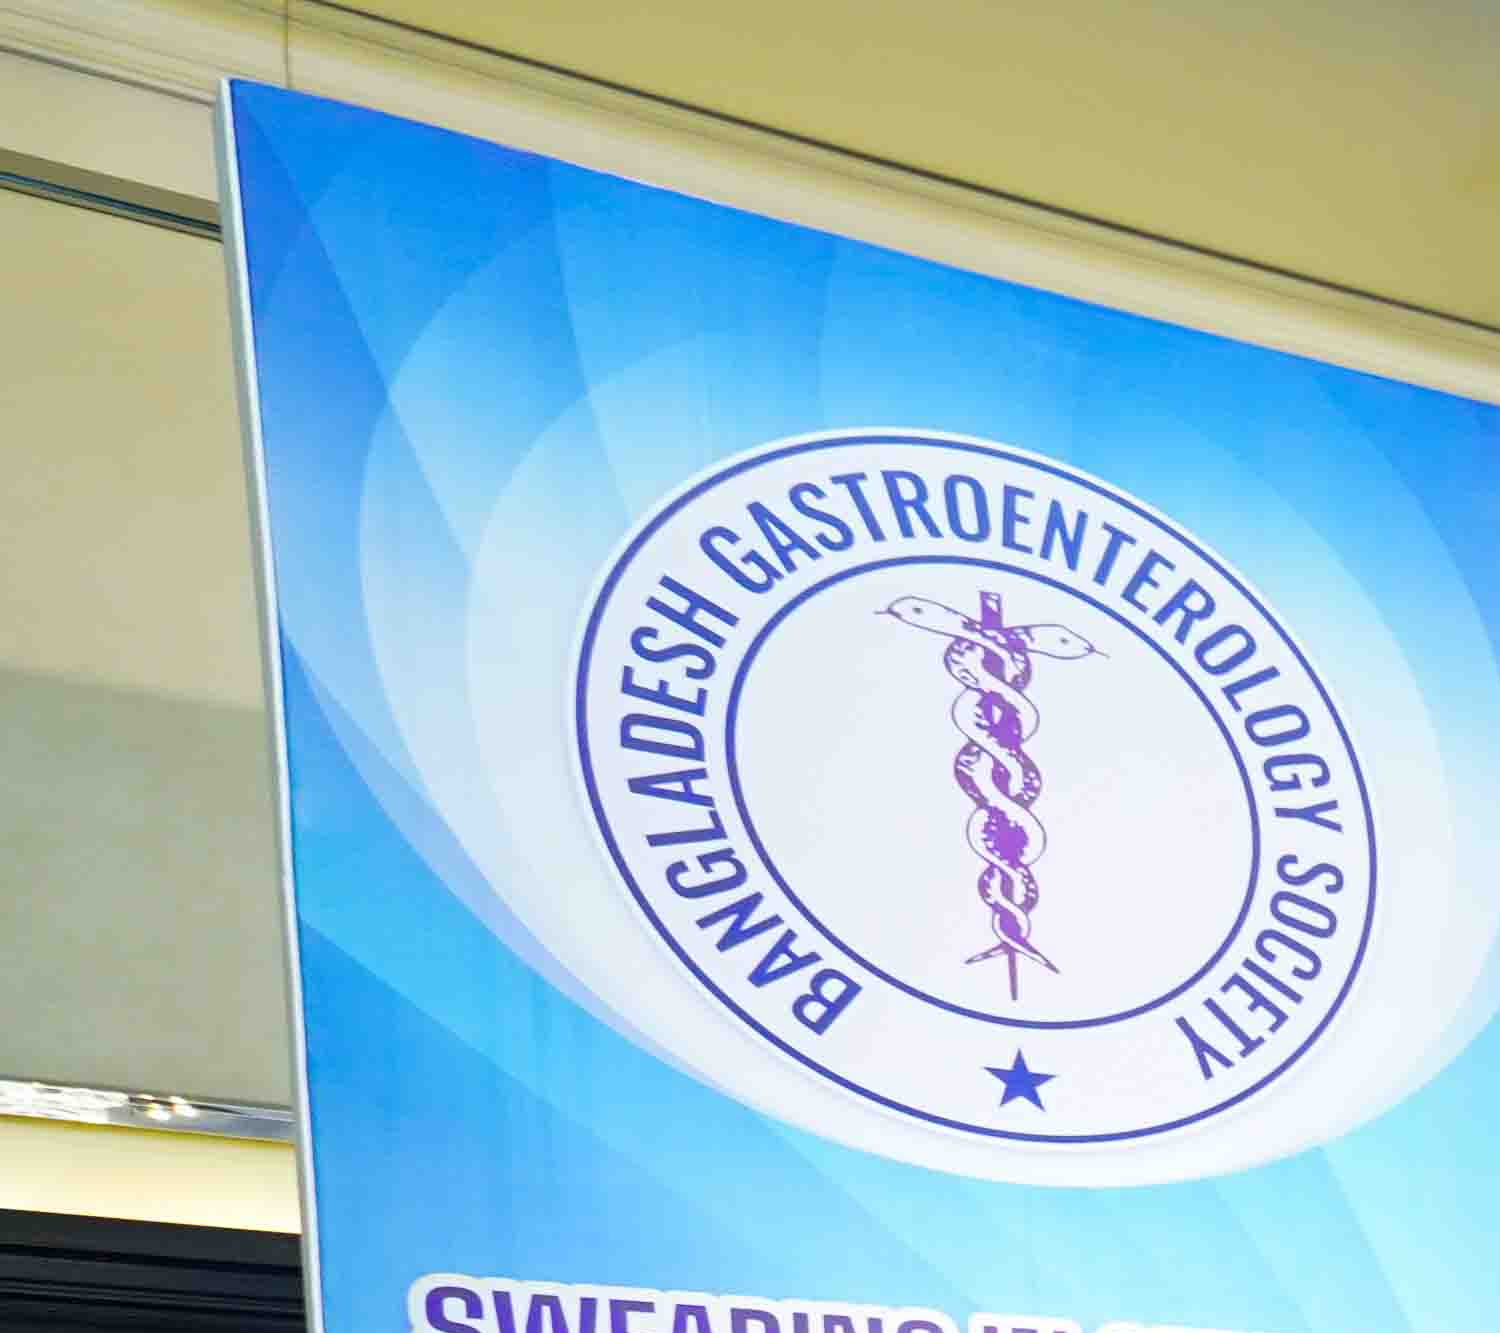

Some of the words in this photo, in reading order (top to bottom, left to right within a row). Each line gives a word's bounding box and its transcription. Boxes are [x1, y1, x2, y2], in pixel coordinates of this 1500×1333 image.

[618, 573, 864, 1039] BANGLADESH
[698, 466, 1343, 835] GASTROENTEROLOGY
[1180, 857, 1345, 1083] SOCIETY
